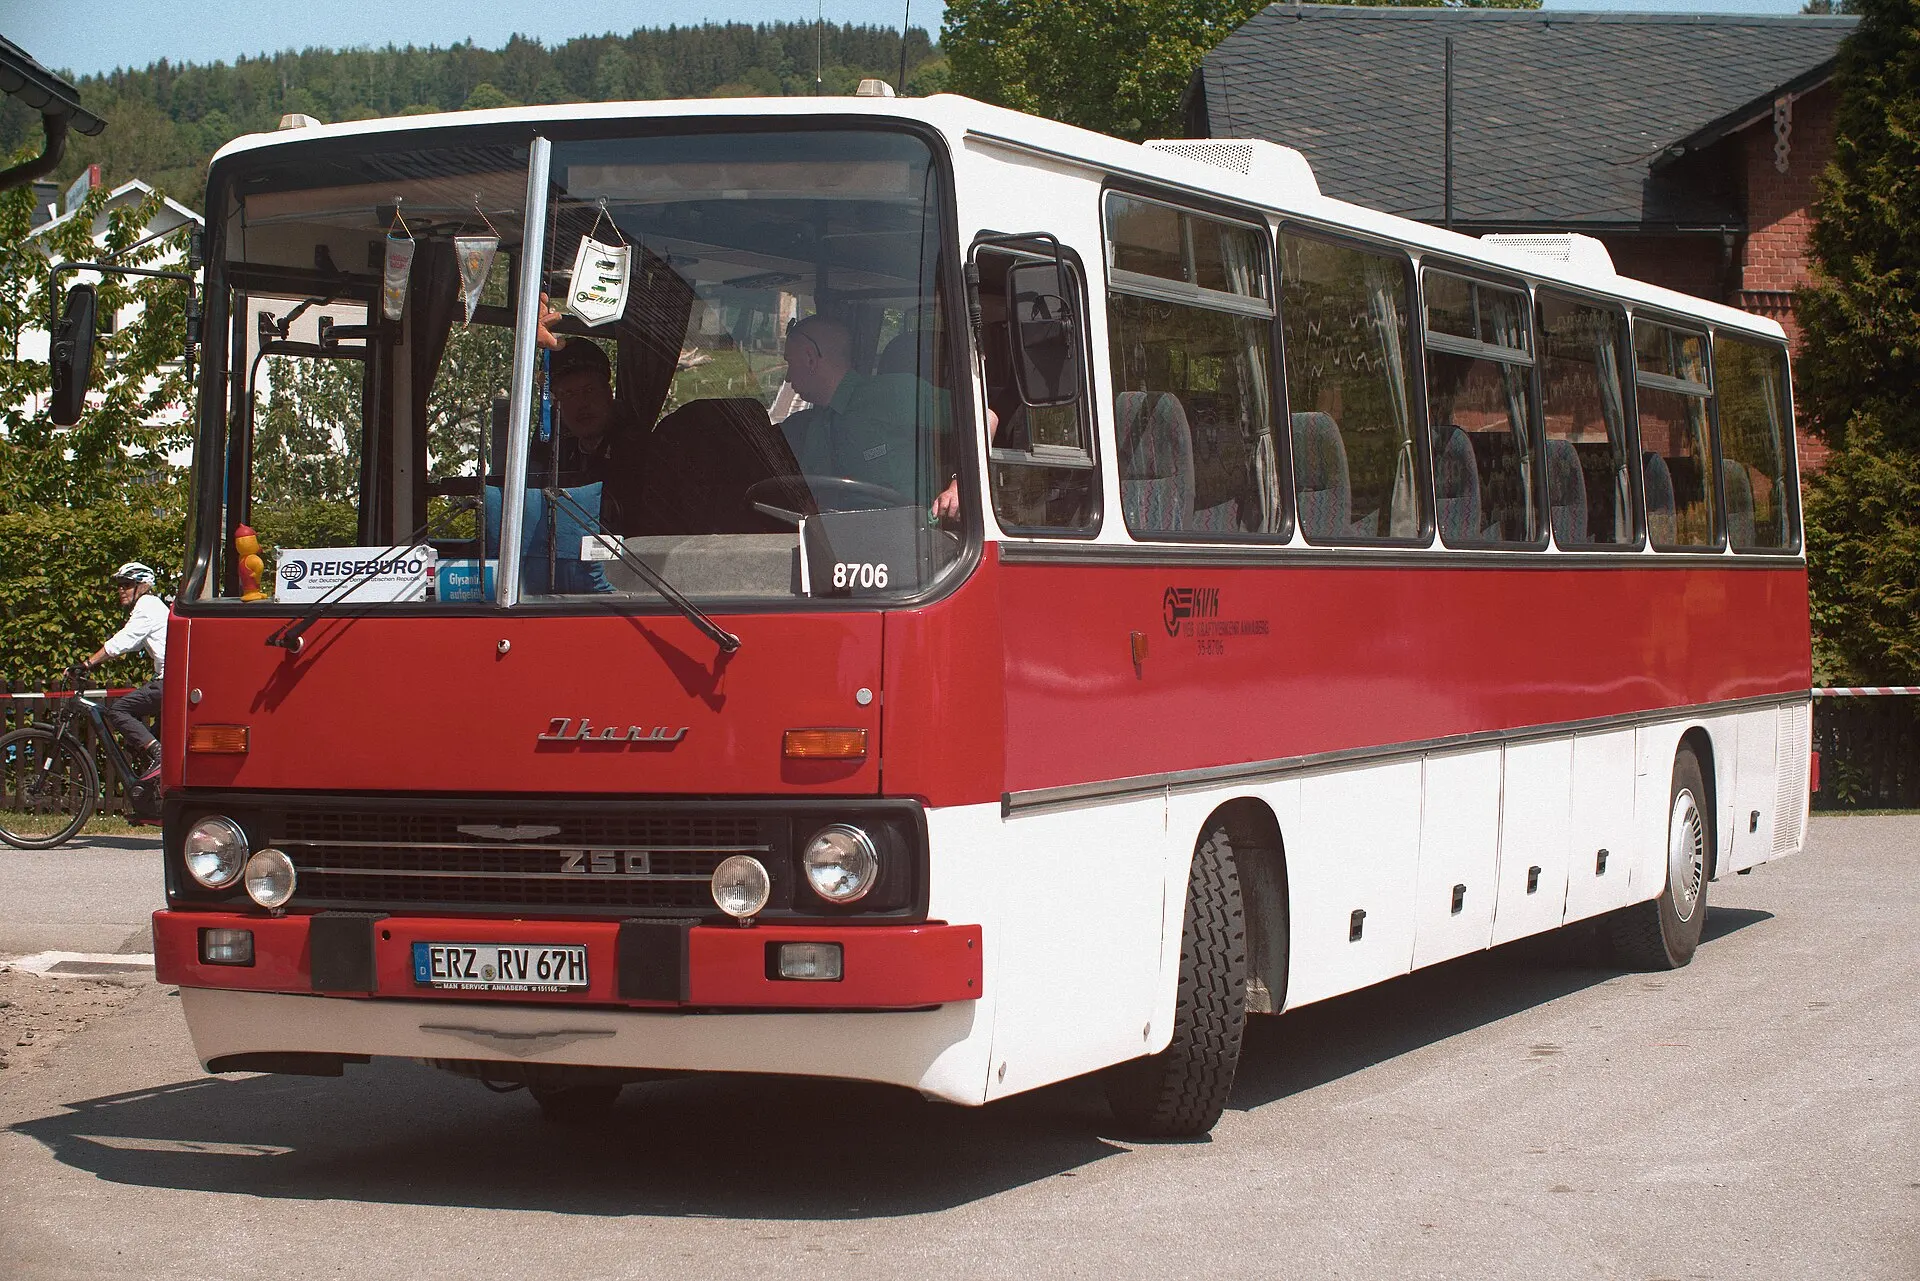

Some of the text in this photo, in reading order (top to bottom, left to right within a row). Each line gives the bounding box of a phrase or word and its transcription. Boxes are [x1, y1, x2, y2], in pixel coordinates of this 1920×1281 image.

[310, 559, 422, 576] REISEBÜRO
[833, 563, 888, 588] 8706
[538, 718, 689, 741] Ikarus
[560, 850, 650, 873] 250
[420, 948, 584, 981] D ERZ RV 67H
[492, 984, 529, 992] ANNABERG
